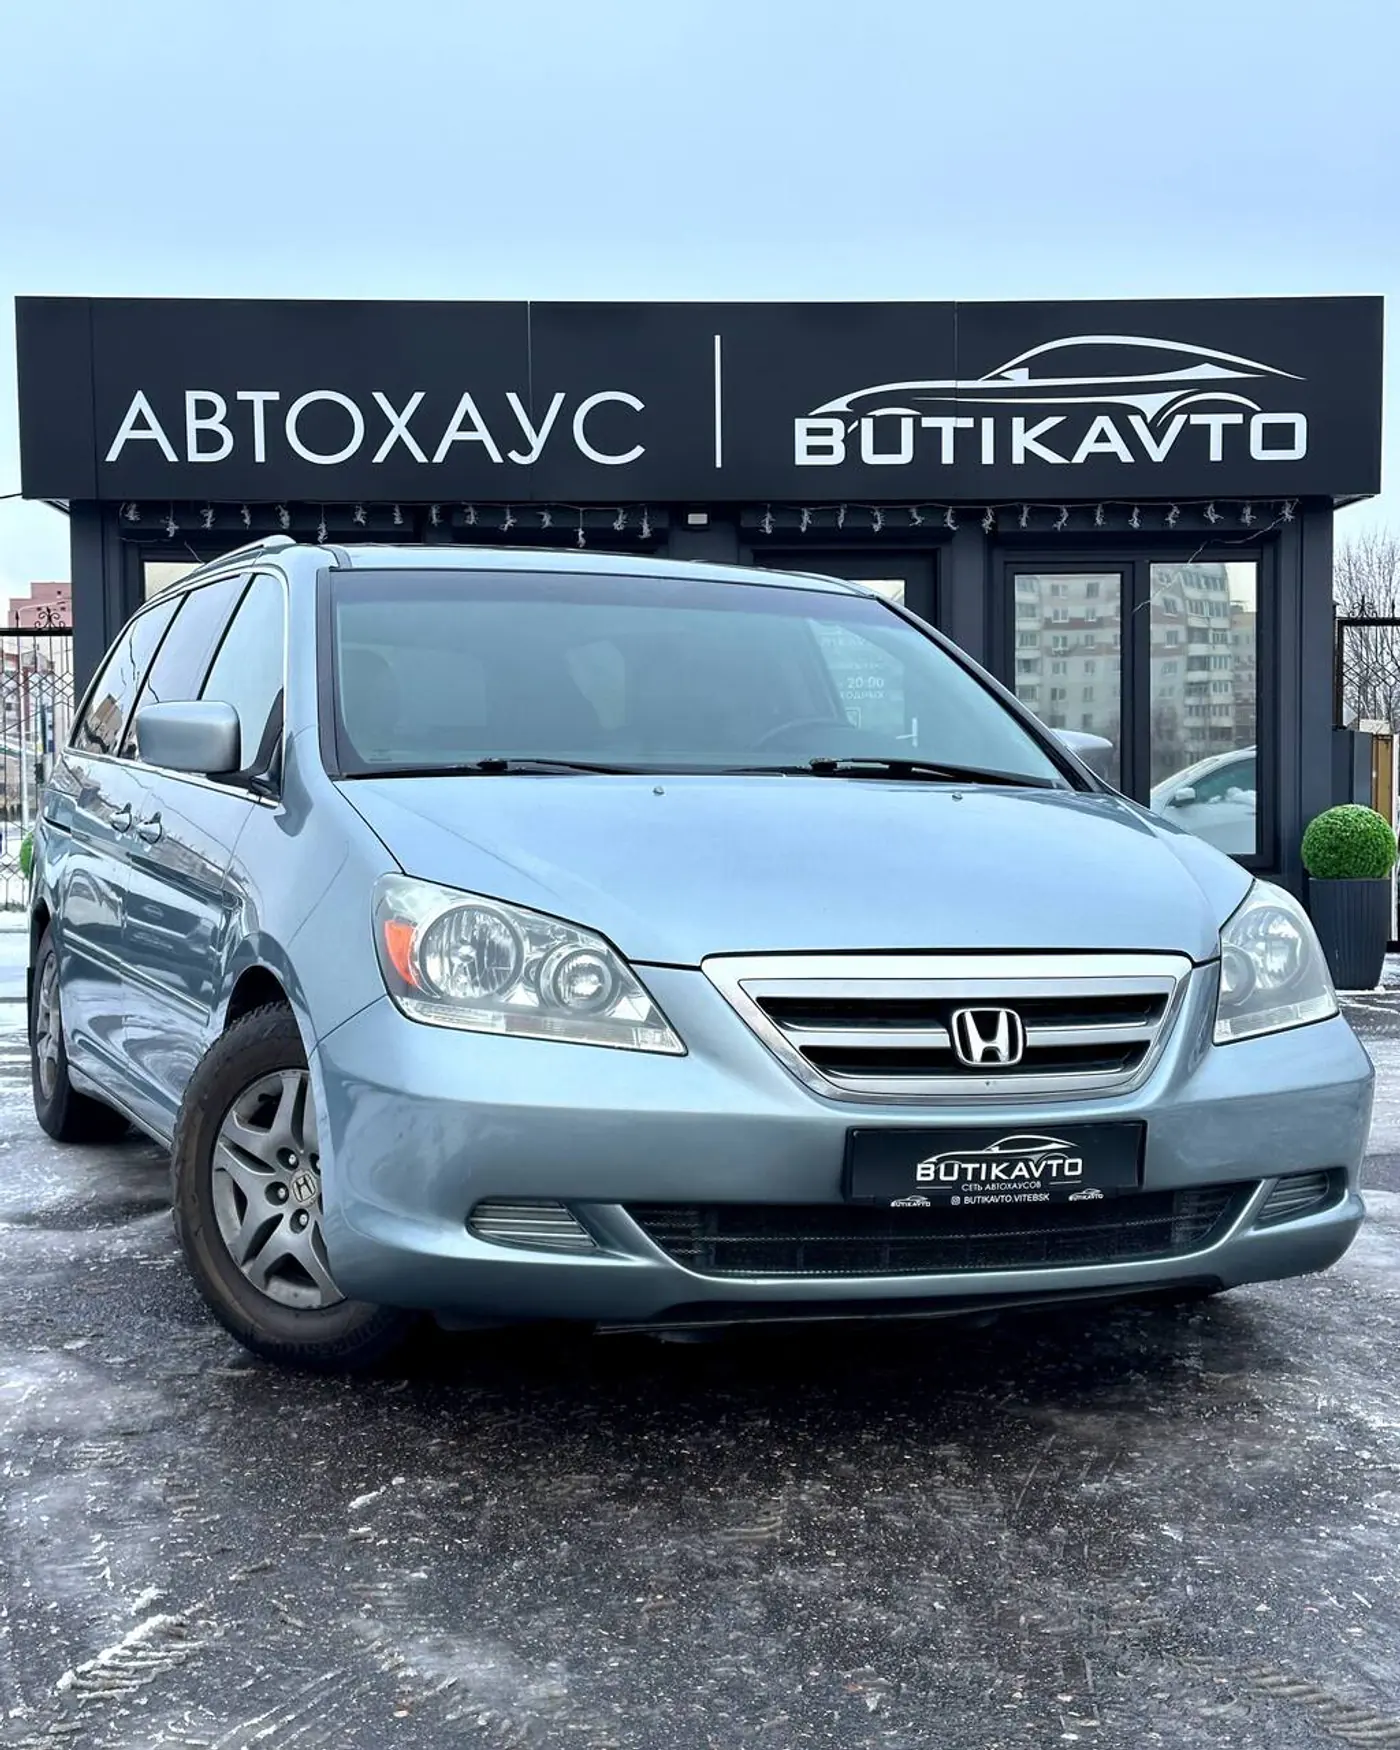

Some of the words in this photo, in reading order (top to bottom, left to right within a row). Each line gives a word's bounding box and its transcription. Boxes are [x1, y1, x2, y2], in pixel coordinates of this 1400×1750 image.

[105, 389, 646, 465] АВТОХАУС
[794, 411, 1308, 465] BUTIKAVTO
[916, 1158, 1082, 1181] BUTIKAVTO
[961, 1183, 983, 1192] СЕТЬ
[985, 1181, 1041, 1191] АВТОХАУСОВ
[963, 1193, 1050, 1204] BUTIKAVTO.VITEBSK
